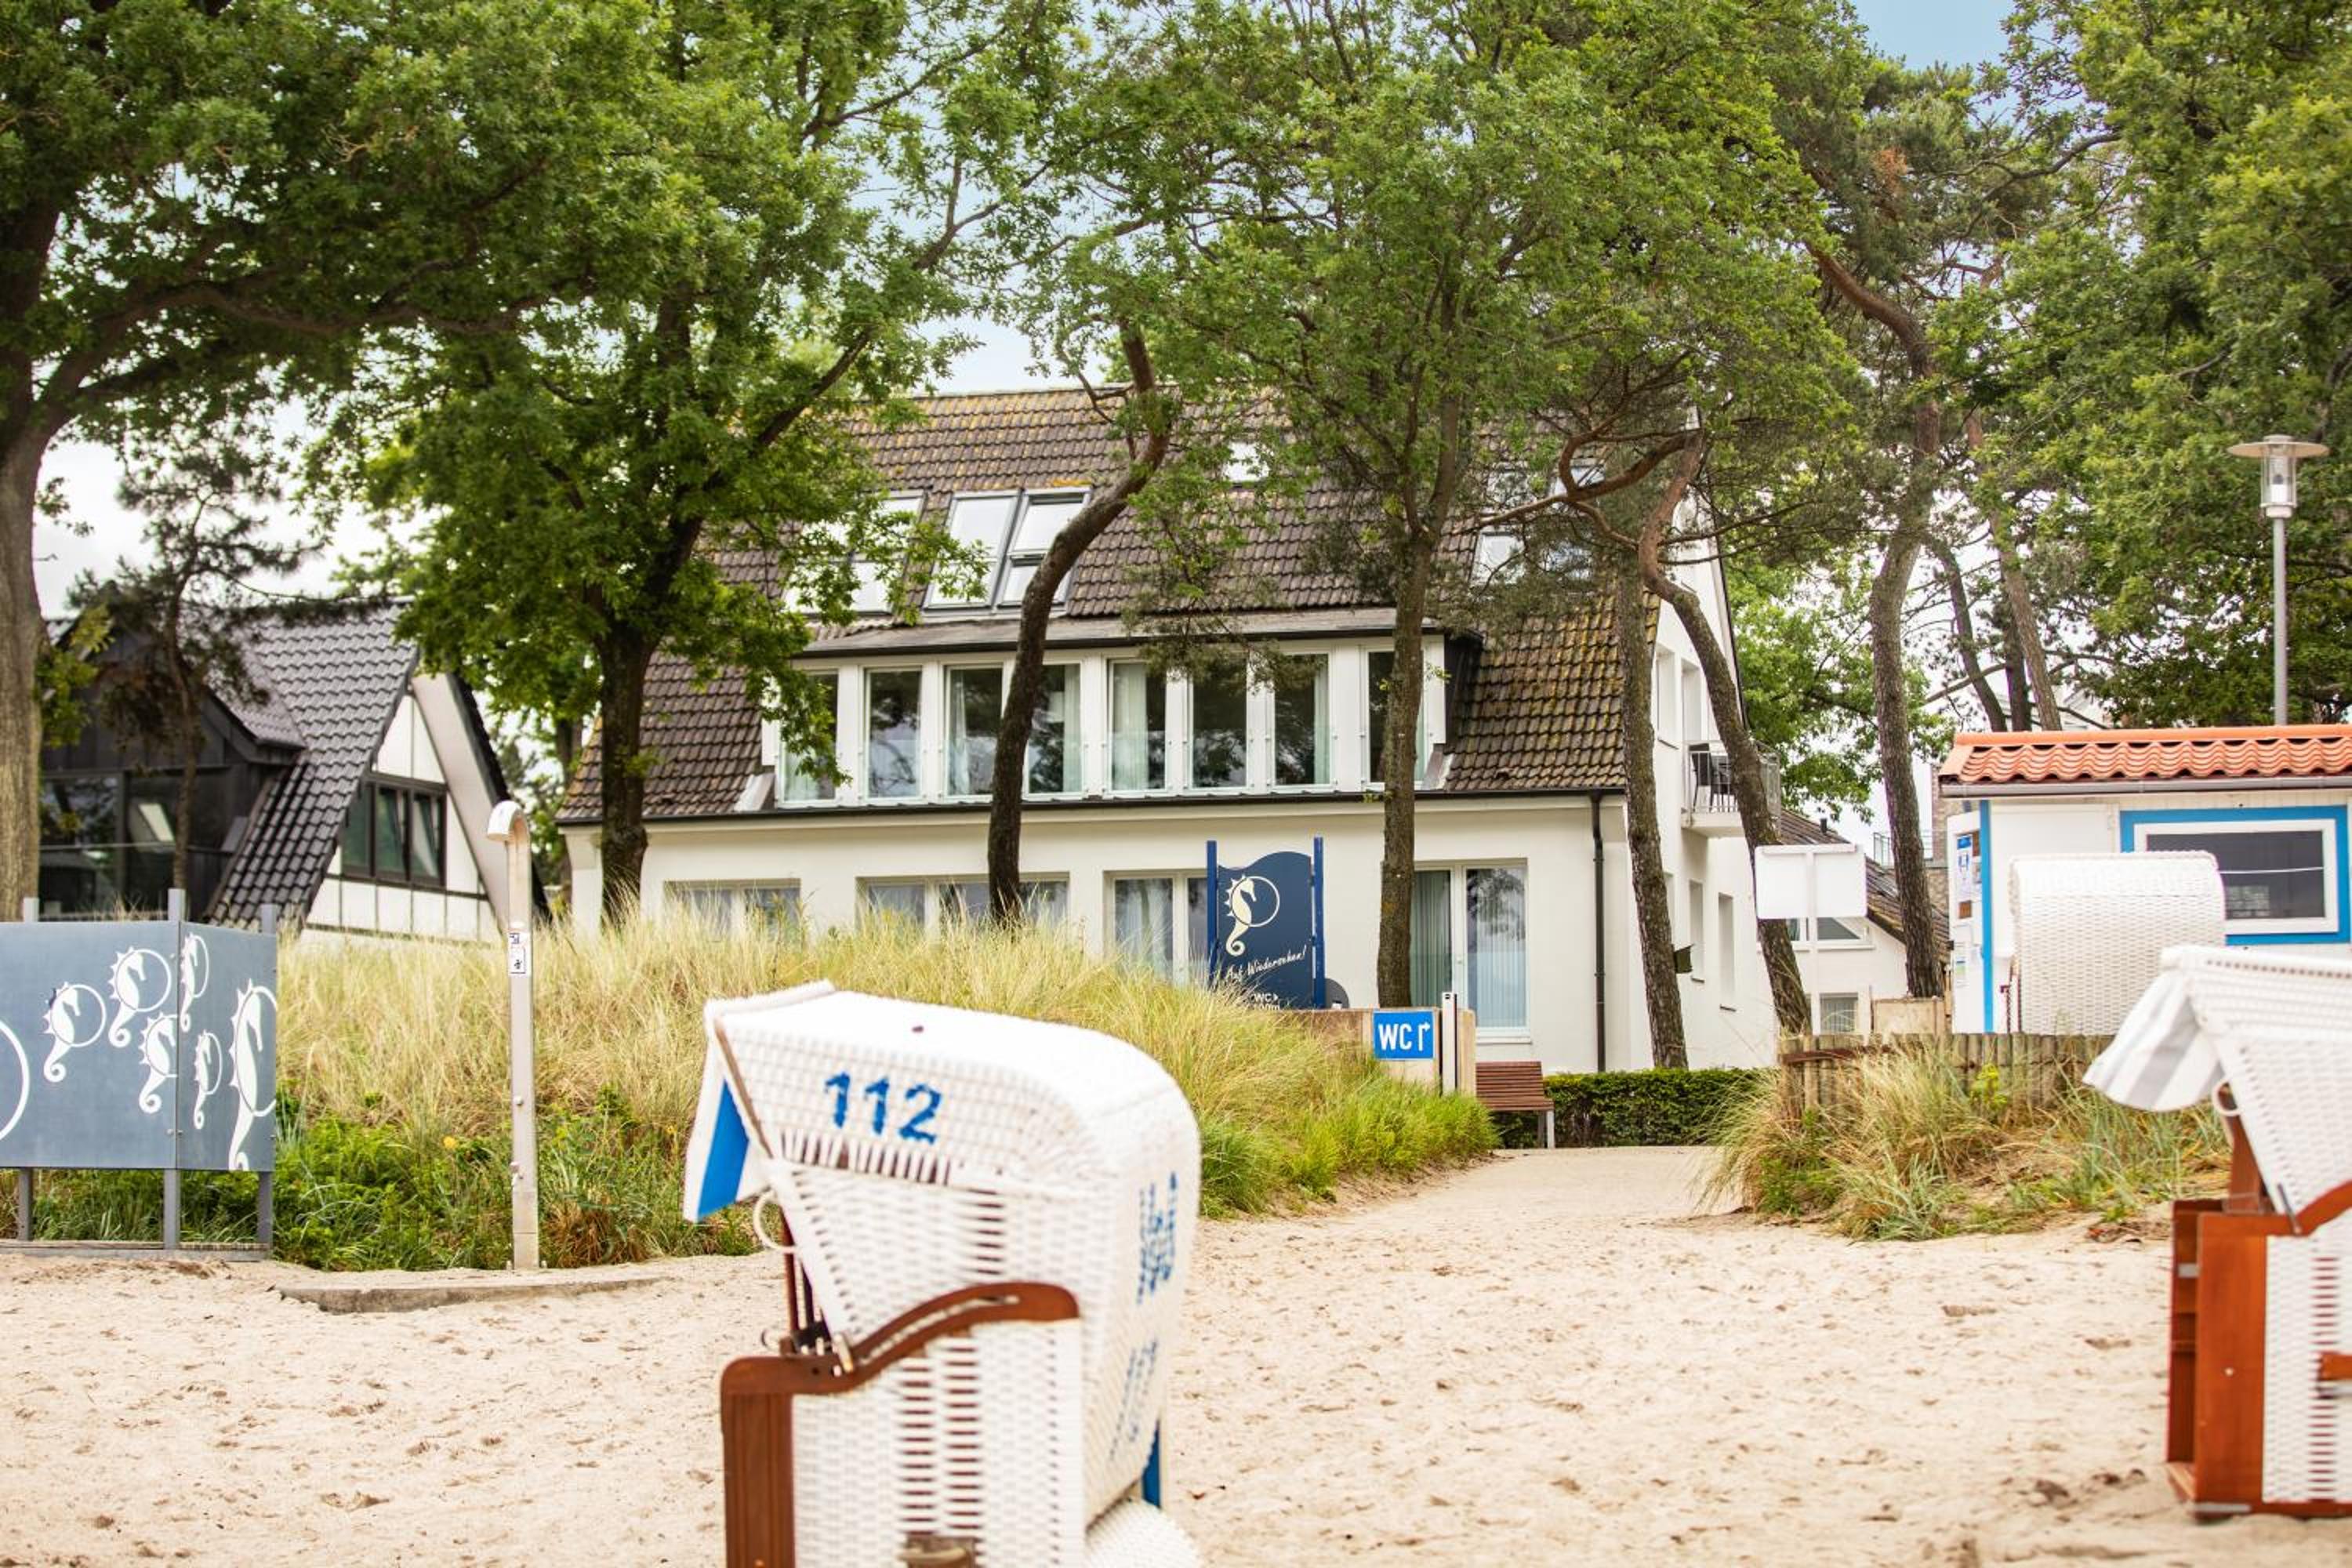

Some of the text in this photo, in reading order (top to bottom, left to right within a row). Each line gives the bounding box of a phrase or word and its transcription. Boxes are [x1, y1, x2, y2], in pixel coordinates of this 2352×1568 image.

[1247, 943, 1307, 975] Wiedersehen!
[1254, 993, 1272, 1003] WC
[1377, 1022, 1413, 1051] WC
[825, 1071, 942, 1145] 112
